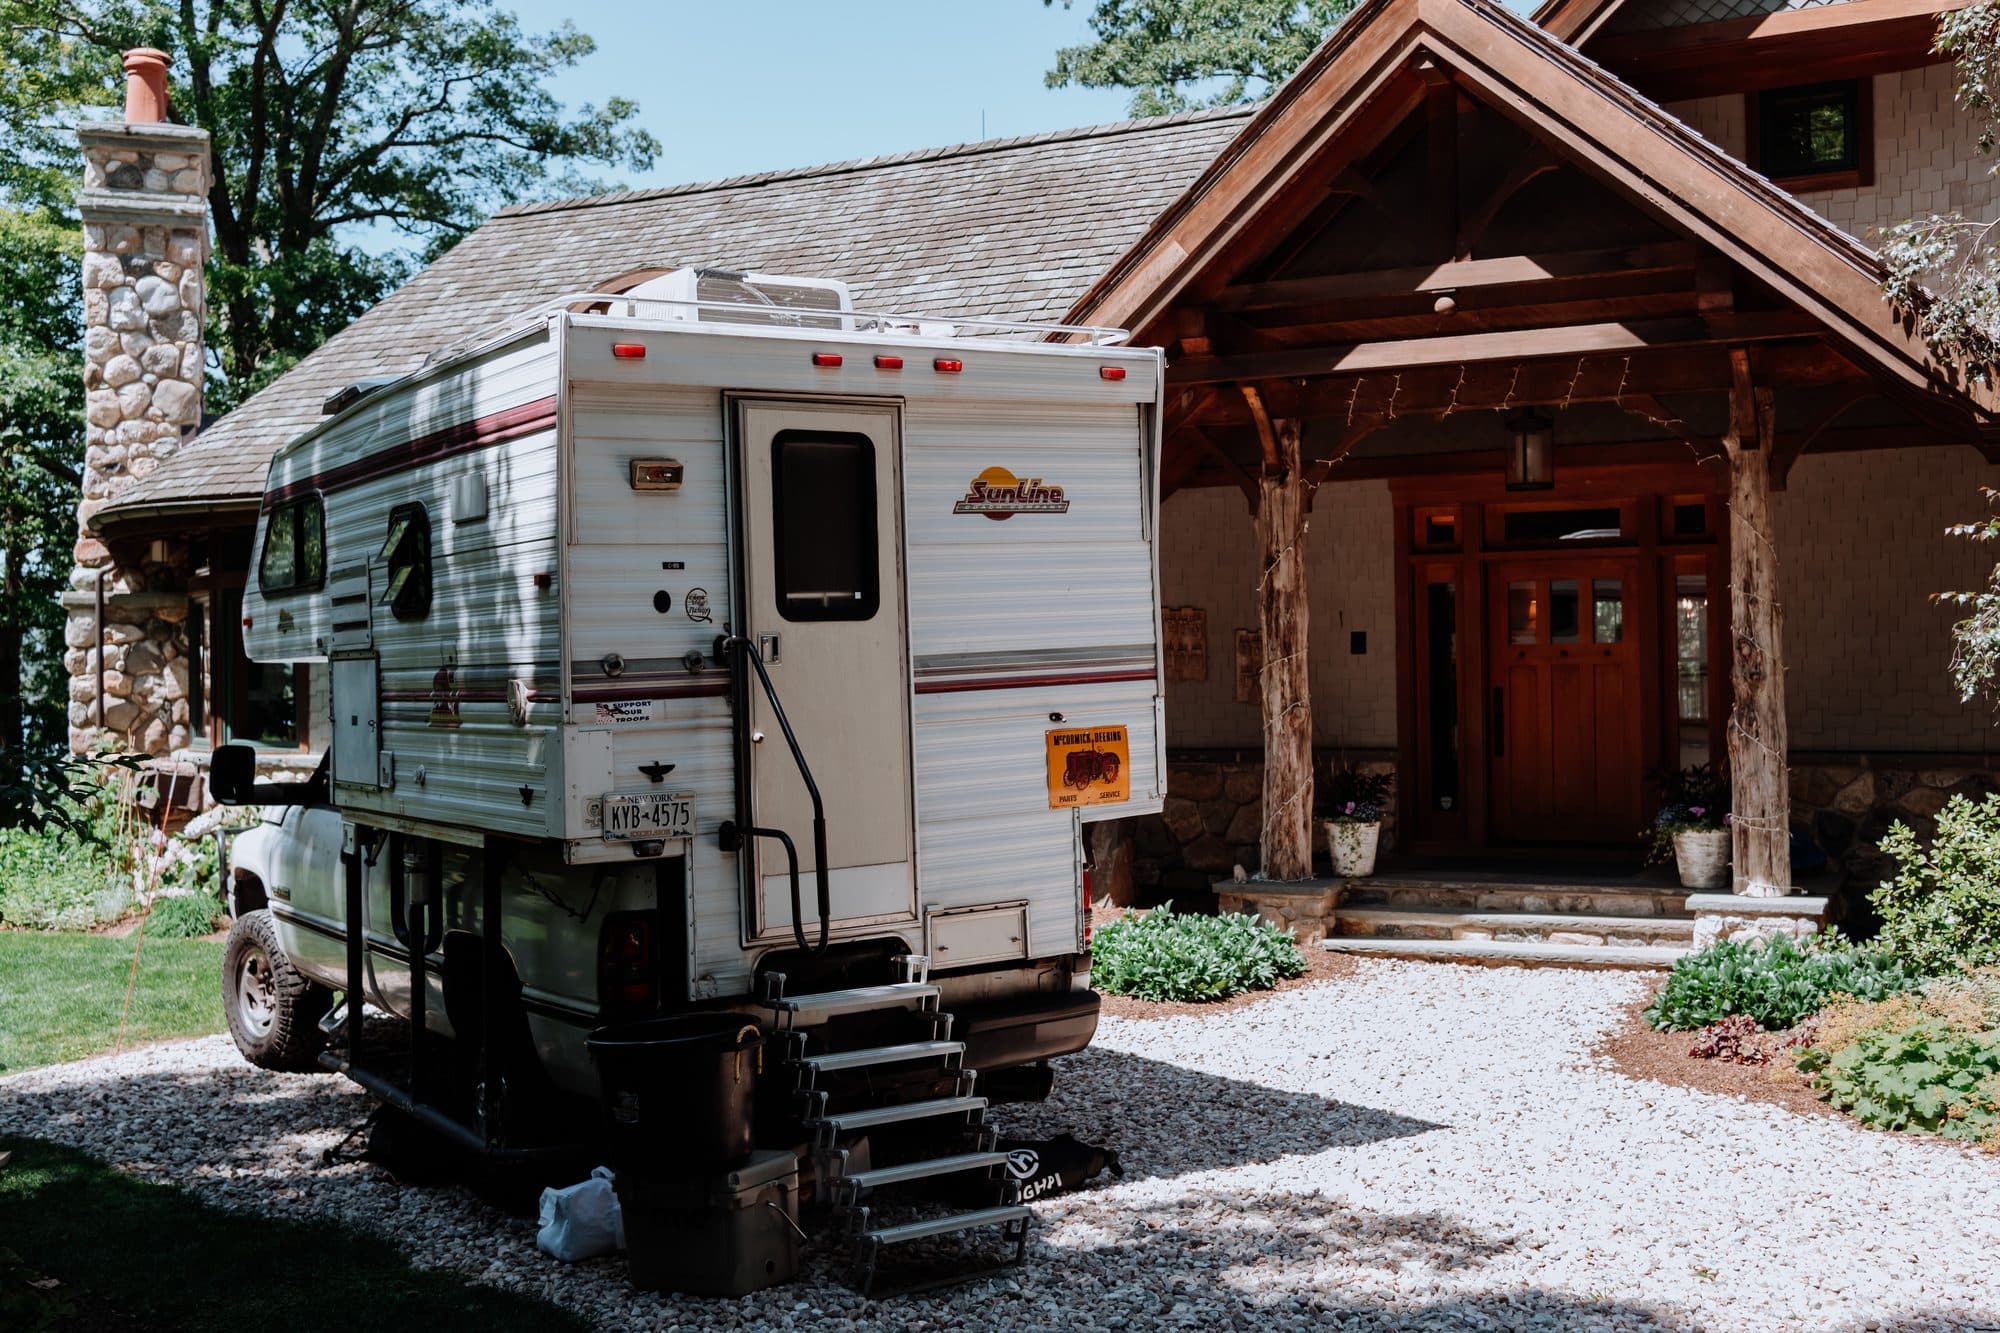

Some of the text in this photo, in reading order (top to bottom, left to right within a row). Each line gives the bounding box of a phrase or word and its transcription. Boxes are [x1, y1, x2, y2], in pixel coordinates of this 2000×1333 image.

[967, 480, 1062, 503] SunLine
[1094, 731, 1122, 743] DEERING
[627, 794, 673, 804] NEW YORK
[1099, 791, 1121, 799] SERVICE
[612, 805, 640, 830] KYB
[652, 802, 690, 826] 4575
